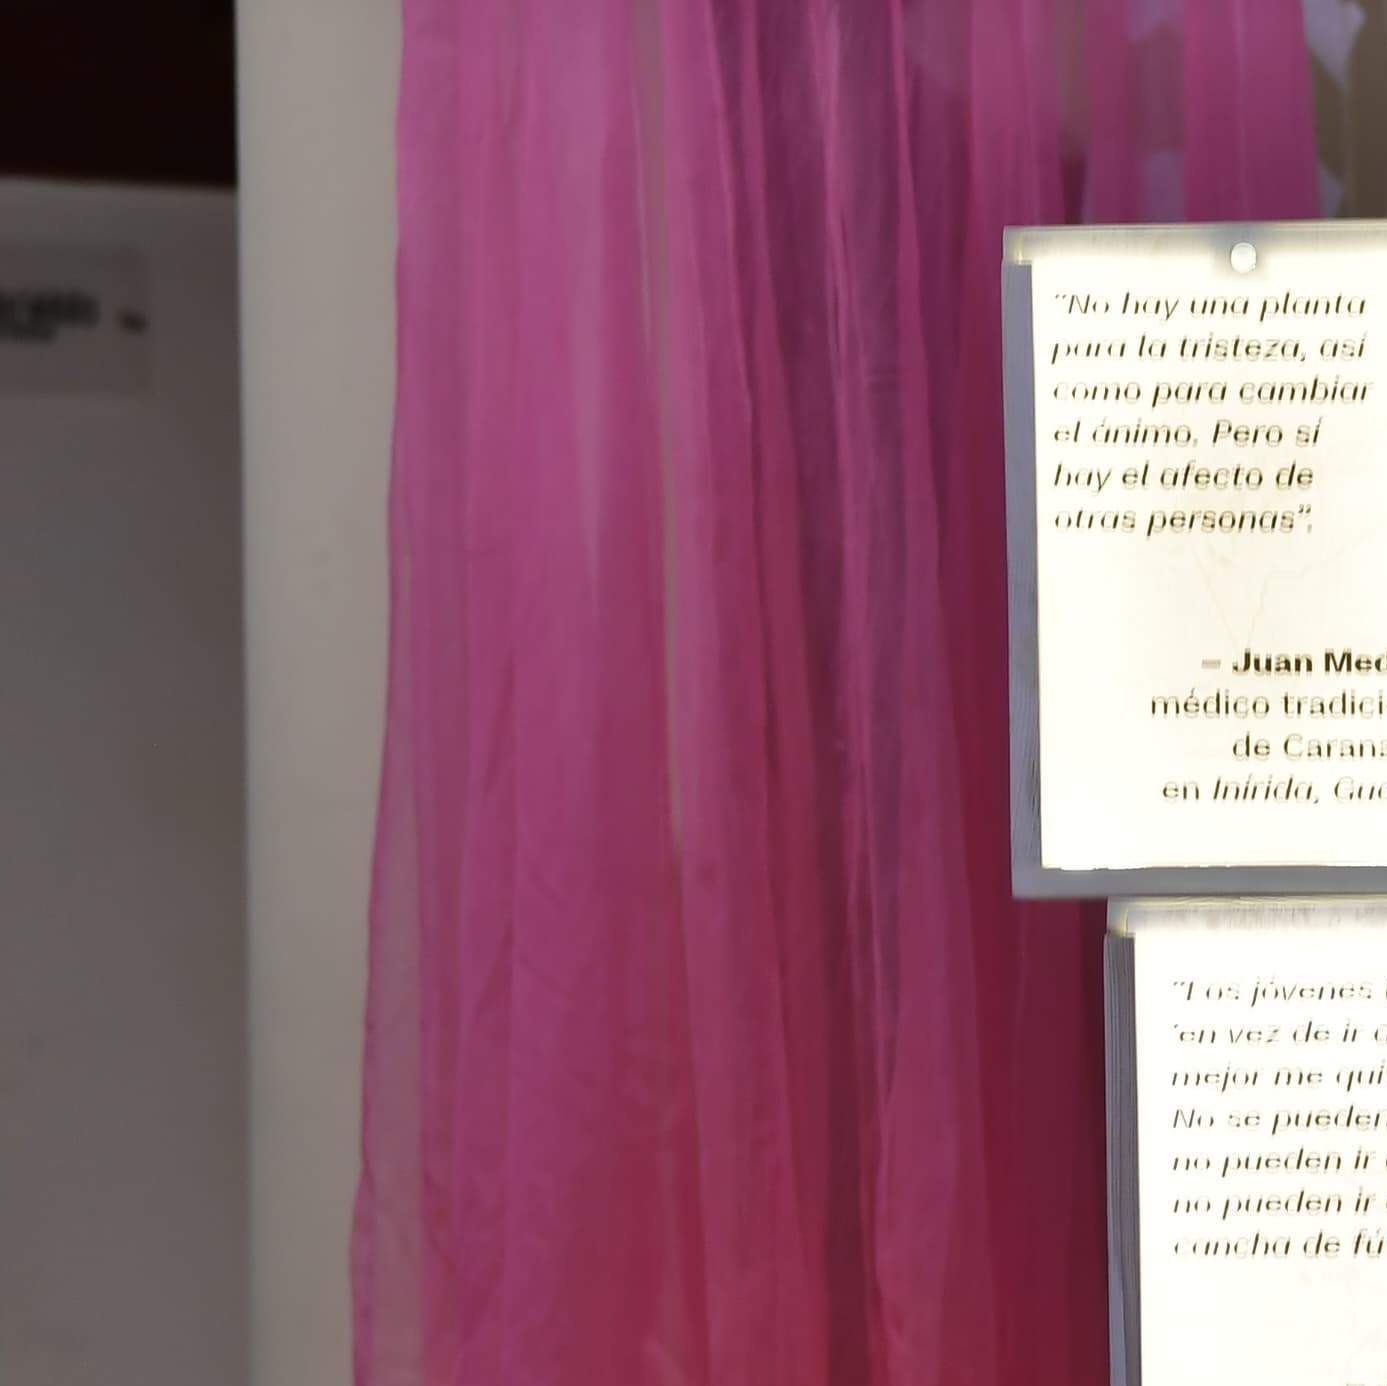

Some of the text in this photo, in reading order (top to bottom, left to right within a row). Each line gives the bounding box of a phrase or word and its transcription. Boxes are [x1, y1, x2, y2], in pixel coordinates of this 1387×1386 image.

[1120, 290, 1367, 324] hay una planta
[1050, 332, 1307, 366] para la tristeza,
[1052, 374, 1375, 410] como para cambiar
[1211, 418, 1284, 448] Pero
[1053, 459, 1314, 494] hay afecto de
[1054, 508, 1137, 534] otras
[1231, 647, 1314, 677] Juan
[1150, 687, 1271, 720] médico
[1231, 730, 1272, 762] de
[1161, 781, 1201, 802] en
[1212, 773, 1320, 805] Inírida,
[1250, 976, 1373, 1009] jóvenes
[1228, 1024, 1281, 1045] vez
[1292, 1020, 1331, 1044] de
[1171, 1066, 1259, 1093] mejor
[1273, 1067, 1324, 1087] me
[1220, 1146, 1343, 1179] pueden
[1221, 1188, 1343, 1222] pueden
[1173, 1229, 1342, 1259] cancha de
